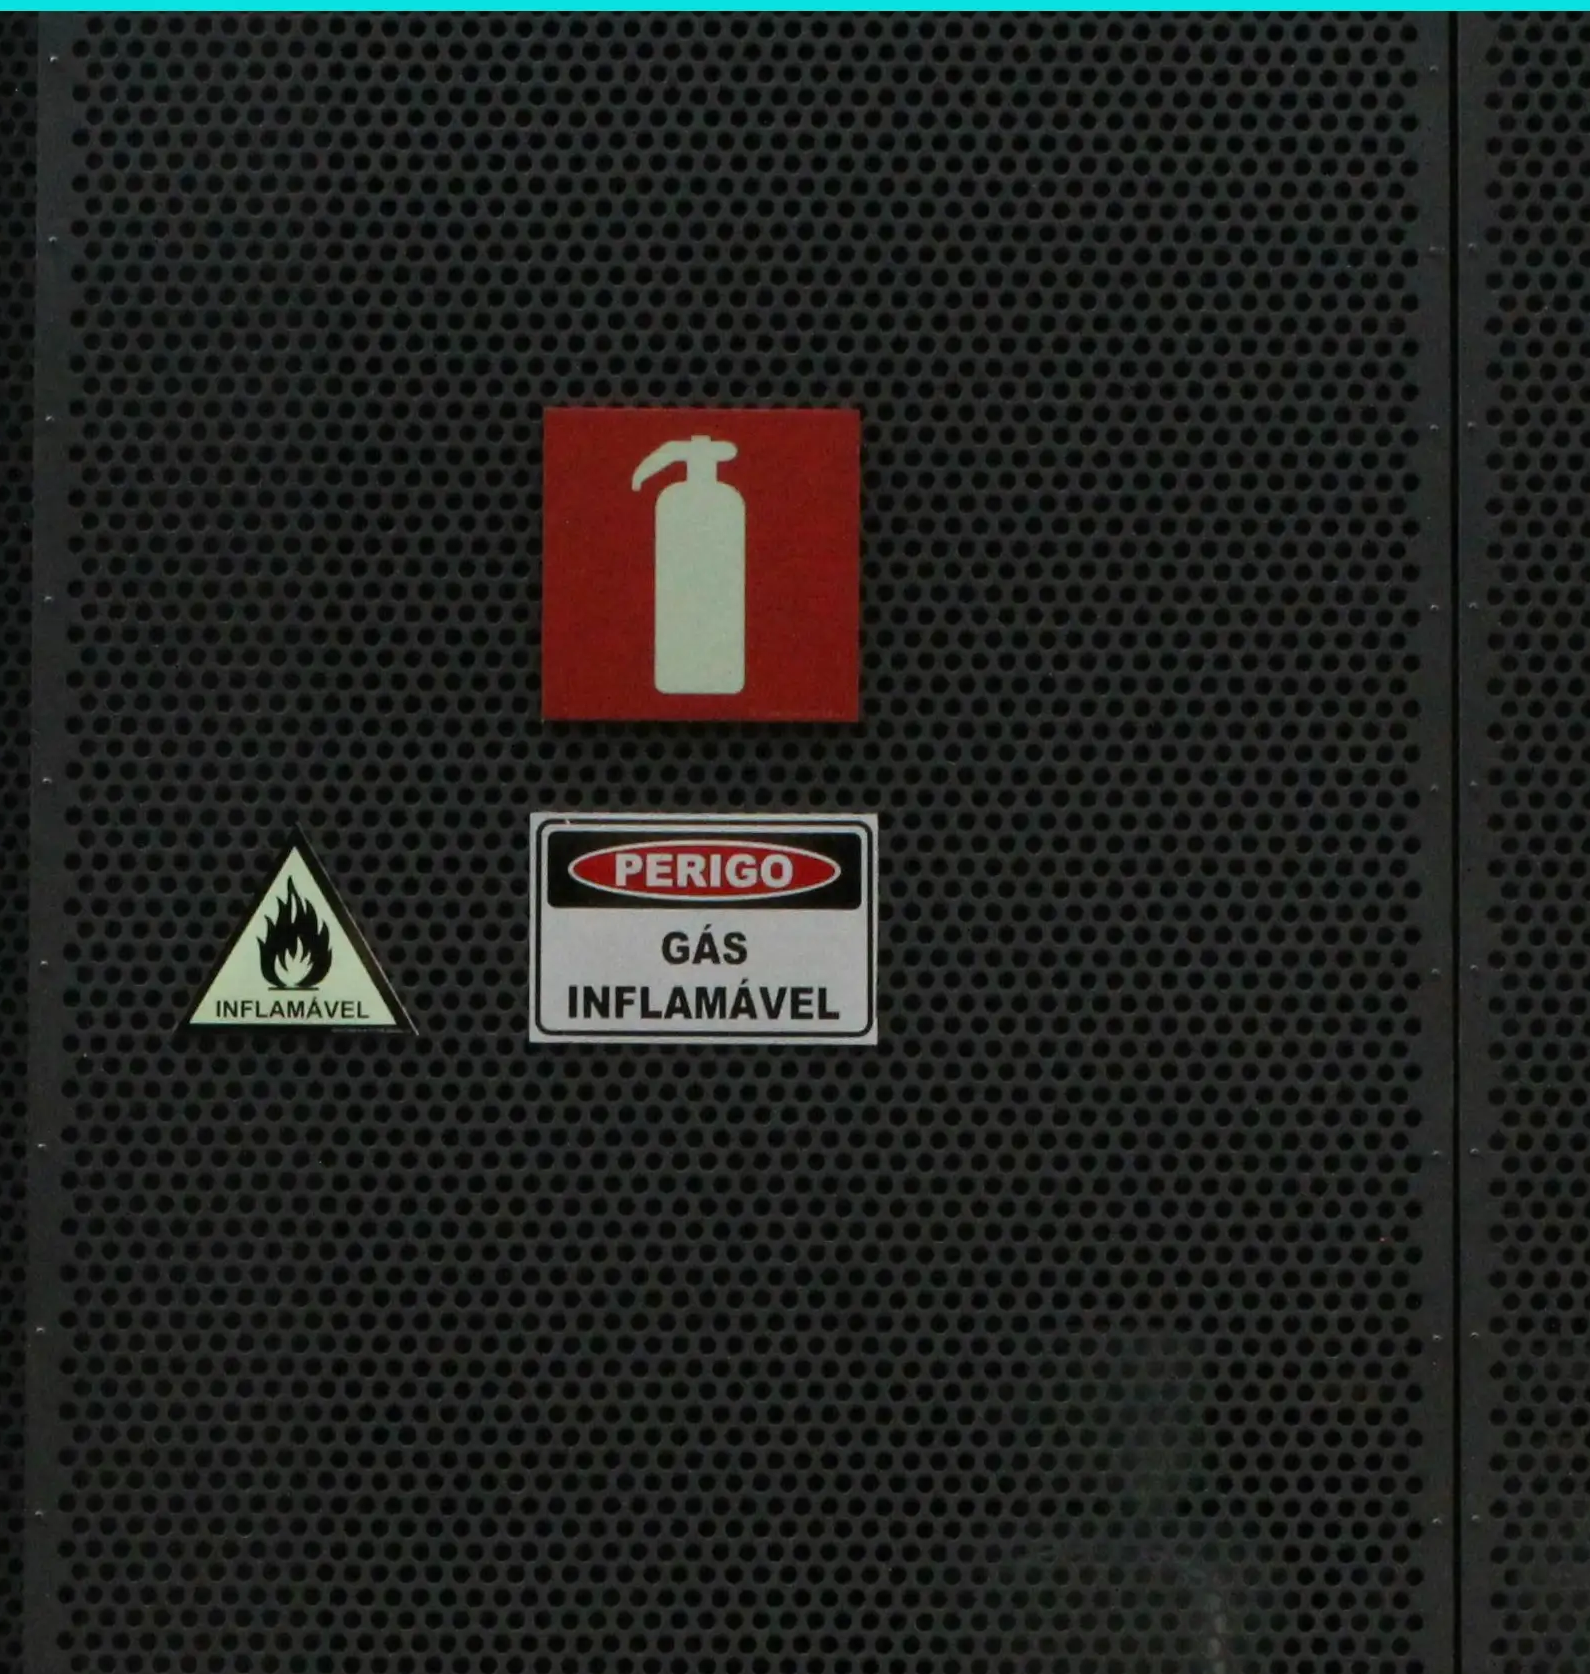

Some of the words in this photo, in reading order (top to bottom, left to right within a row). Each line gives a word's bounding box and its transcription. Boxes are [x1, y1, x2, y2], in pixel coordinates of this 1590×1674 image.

[615, 853, 793, 888] PERIGO
[662, 922, 749, 964] GÁS
[216, 994, 370, 1020] INFLAMÁVEL
[567, 978, 841, 1020] INFLAMÁVEL
